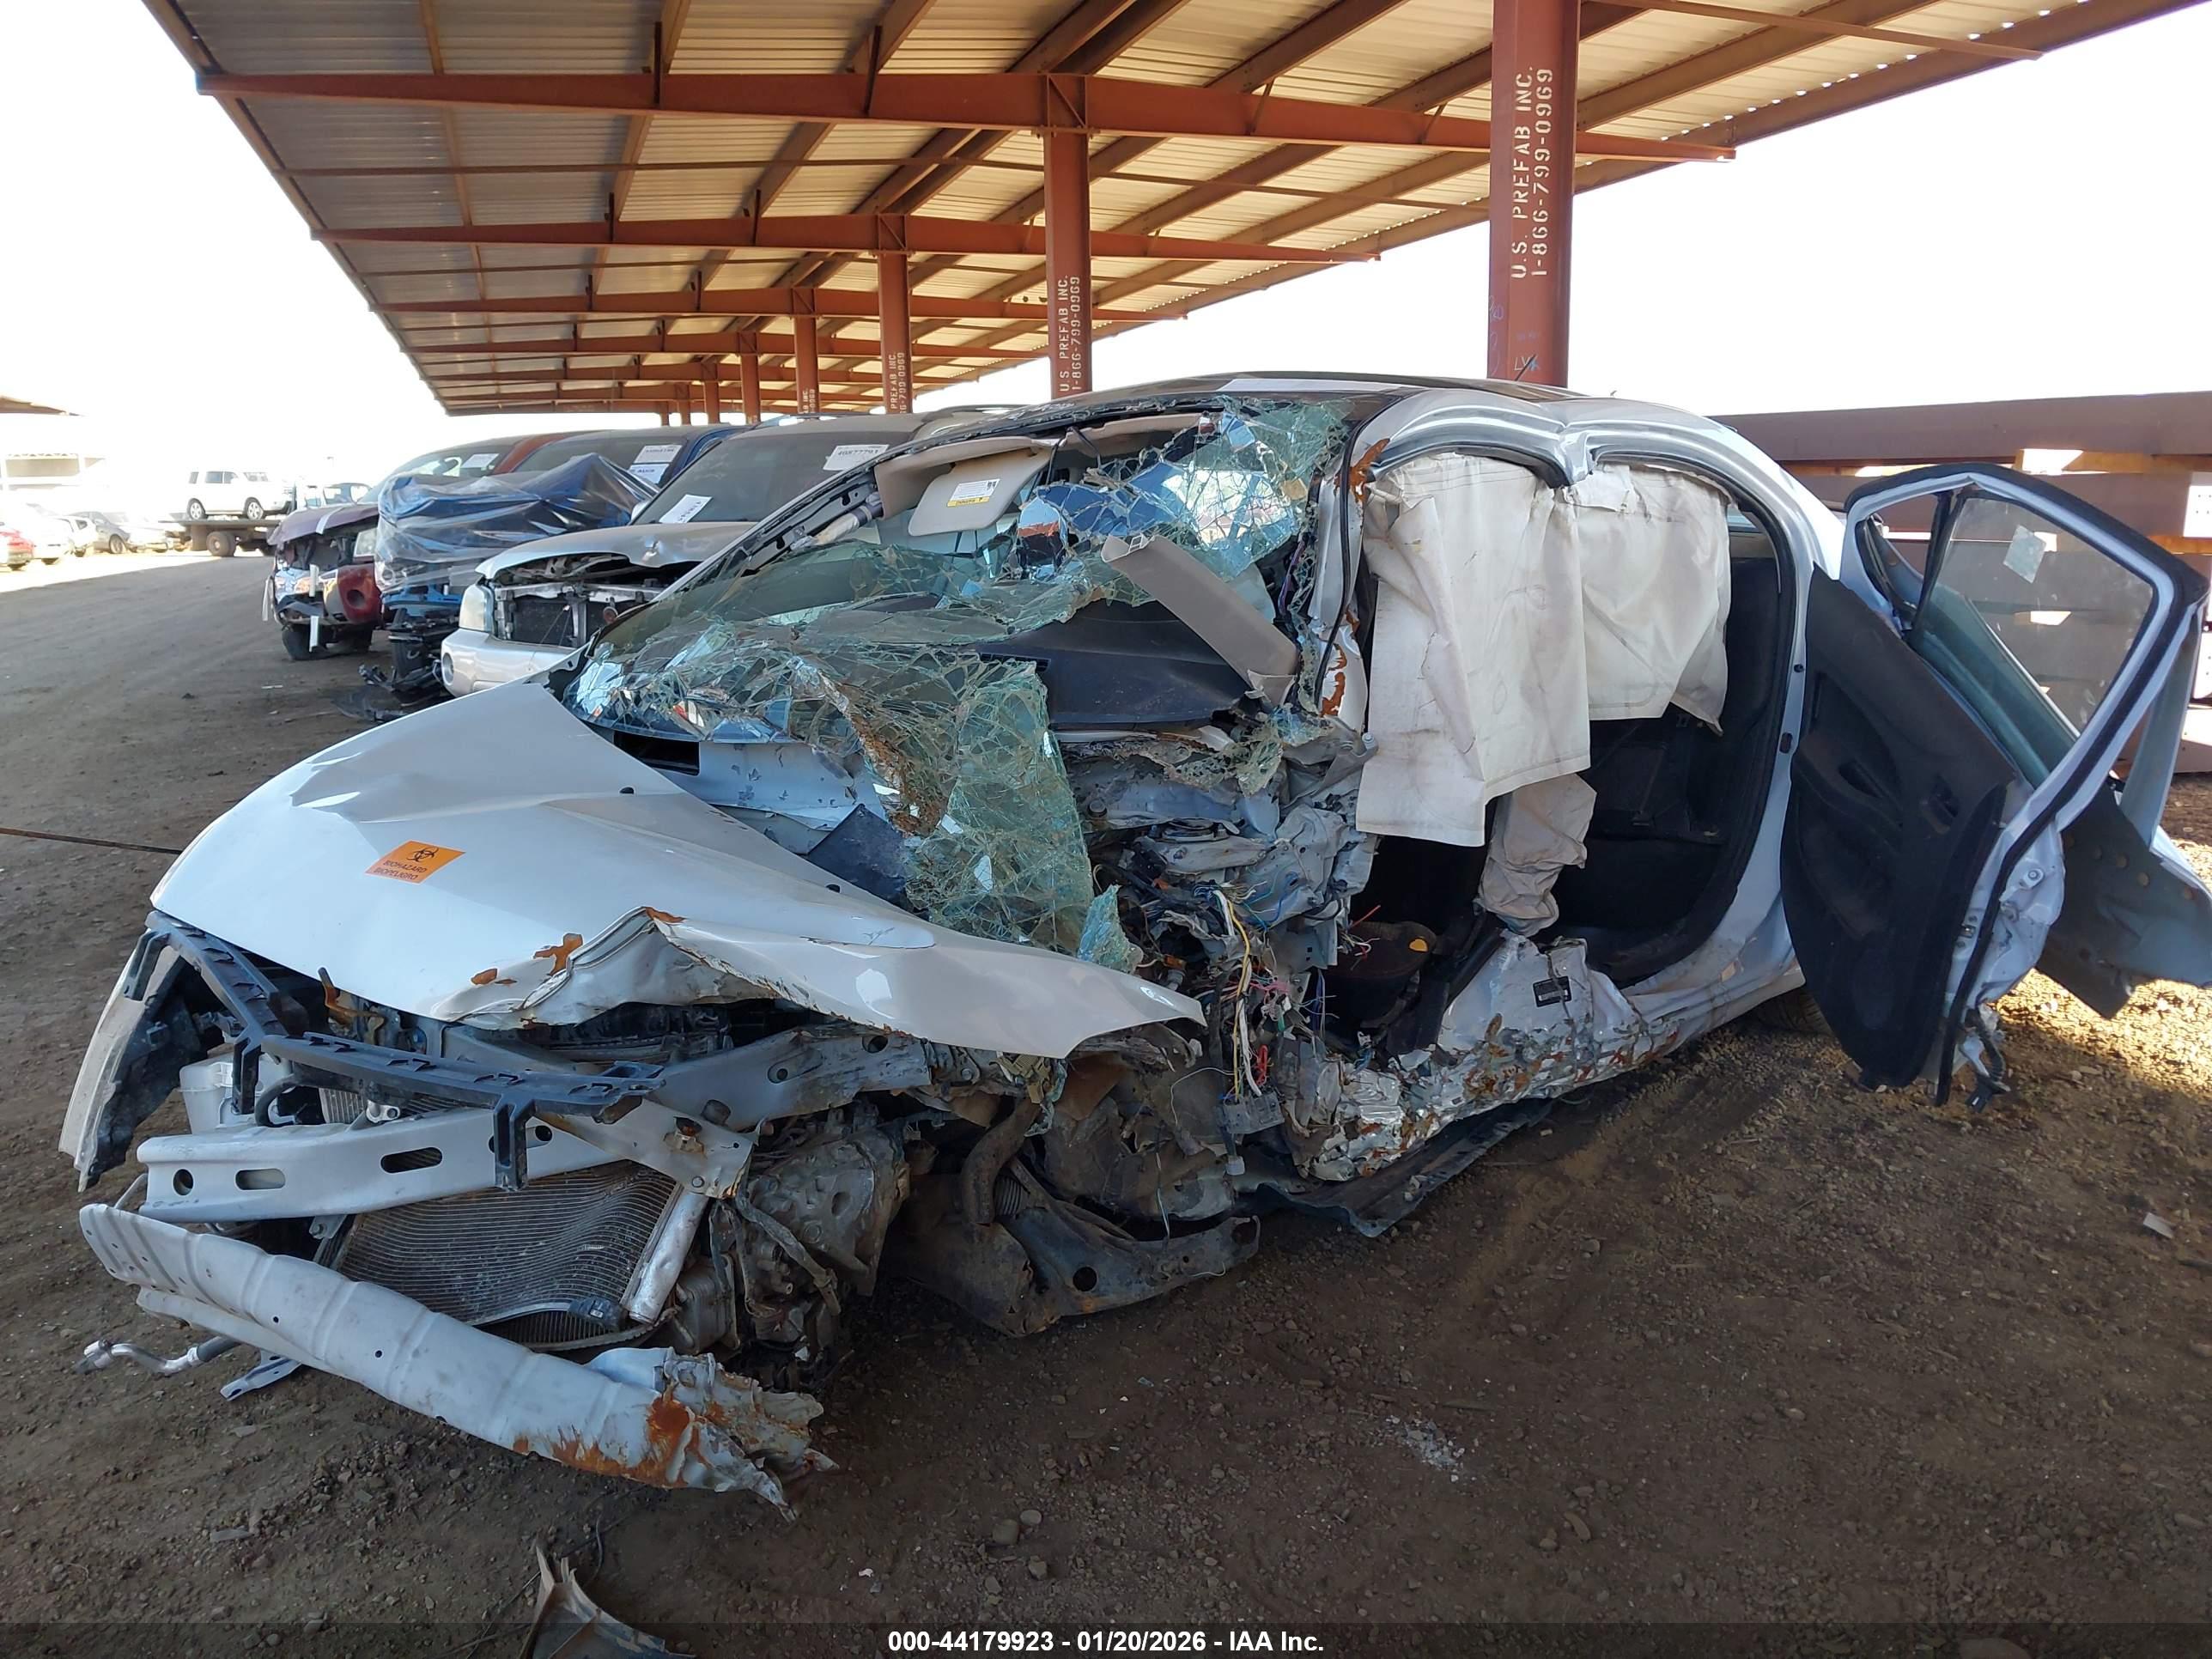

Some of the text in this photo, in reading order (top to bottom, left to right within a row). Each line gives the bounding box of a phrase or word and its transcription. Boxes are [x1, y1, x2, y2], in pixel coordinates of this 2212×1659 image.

[1510, 66, 1533, 278] U.S. PREFAB INC.
[1531, 69, 1553, 276] 1-866-799-0969
[1058, 275, 1068, 301] INC.
[1058, 307, 1070, 359] PREFAB
[1070, 276, 1082, 391] 1-866-799-0969
[889, 374, 898, 410] PREFAB
[374, 866, 418, 880] BIOPELIGRO
[383, 860, 427, 873] BIOHAZARD
